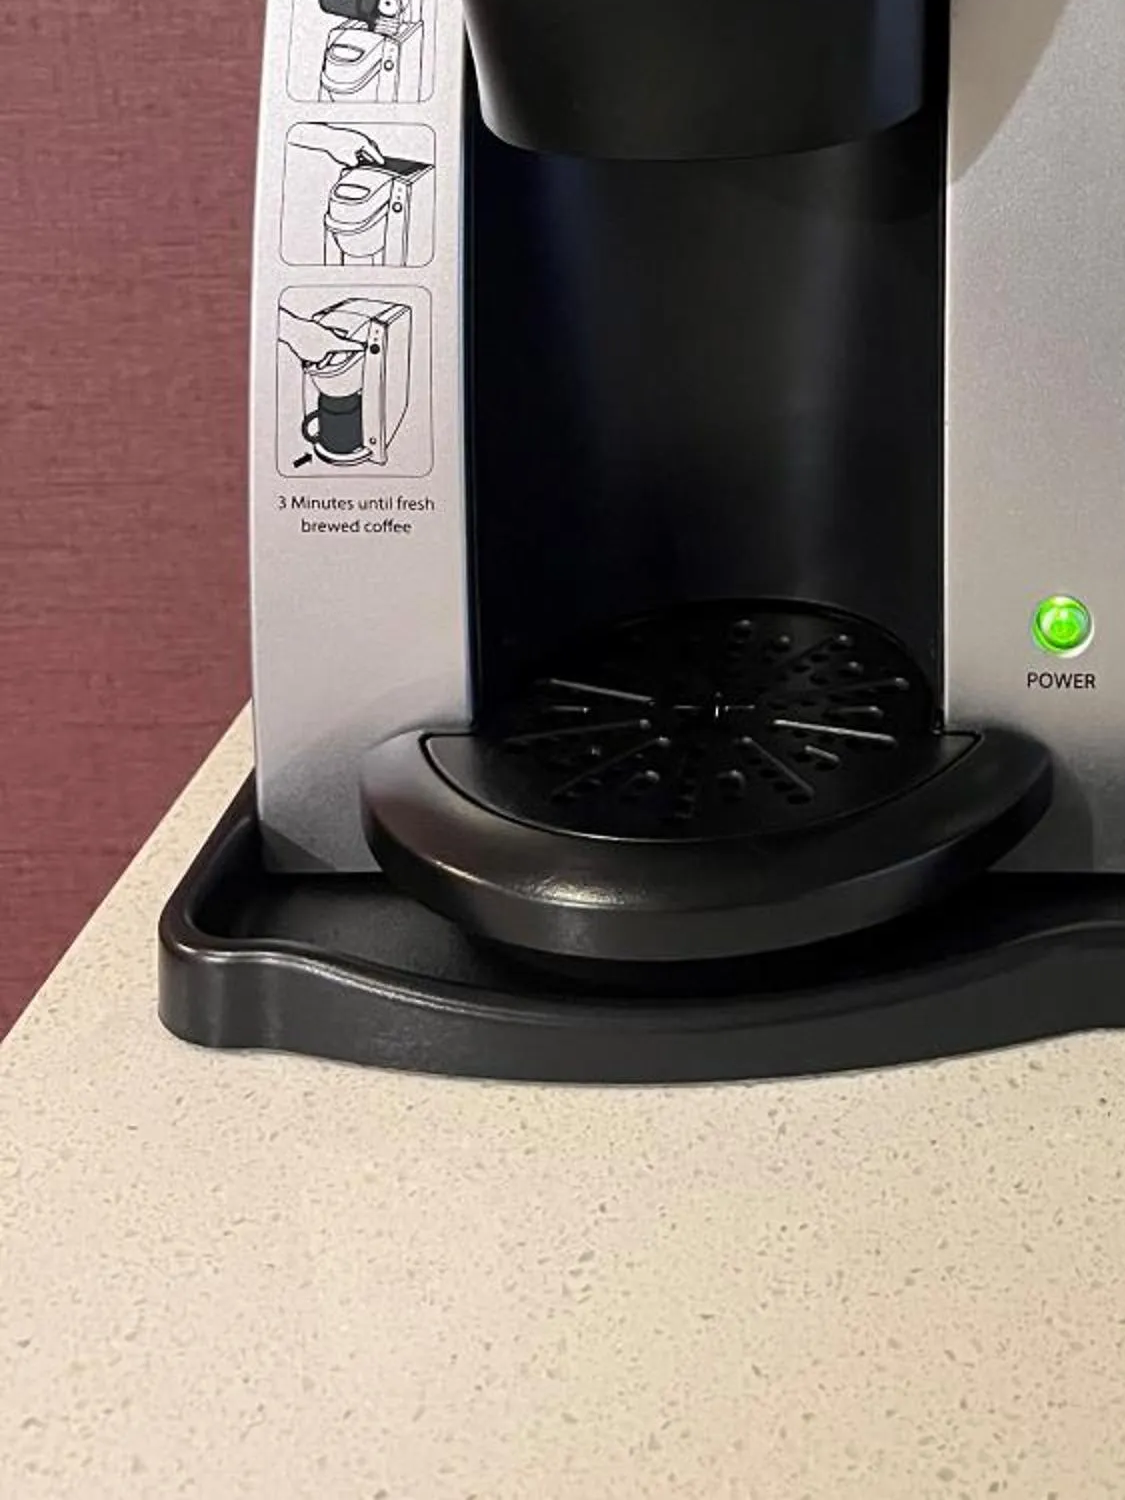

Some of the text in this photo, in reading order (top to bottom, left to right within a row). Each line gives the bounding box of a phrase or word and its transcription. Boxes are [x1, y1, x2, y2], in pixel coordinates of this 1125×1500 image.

[278, 495, 436, 512] 3 Minutes until fresh
[301, 519, 413, 535] brewed coffee
[1026, 670, 1097, 690] POWER
